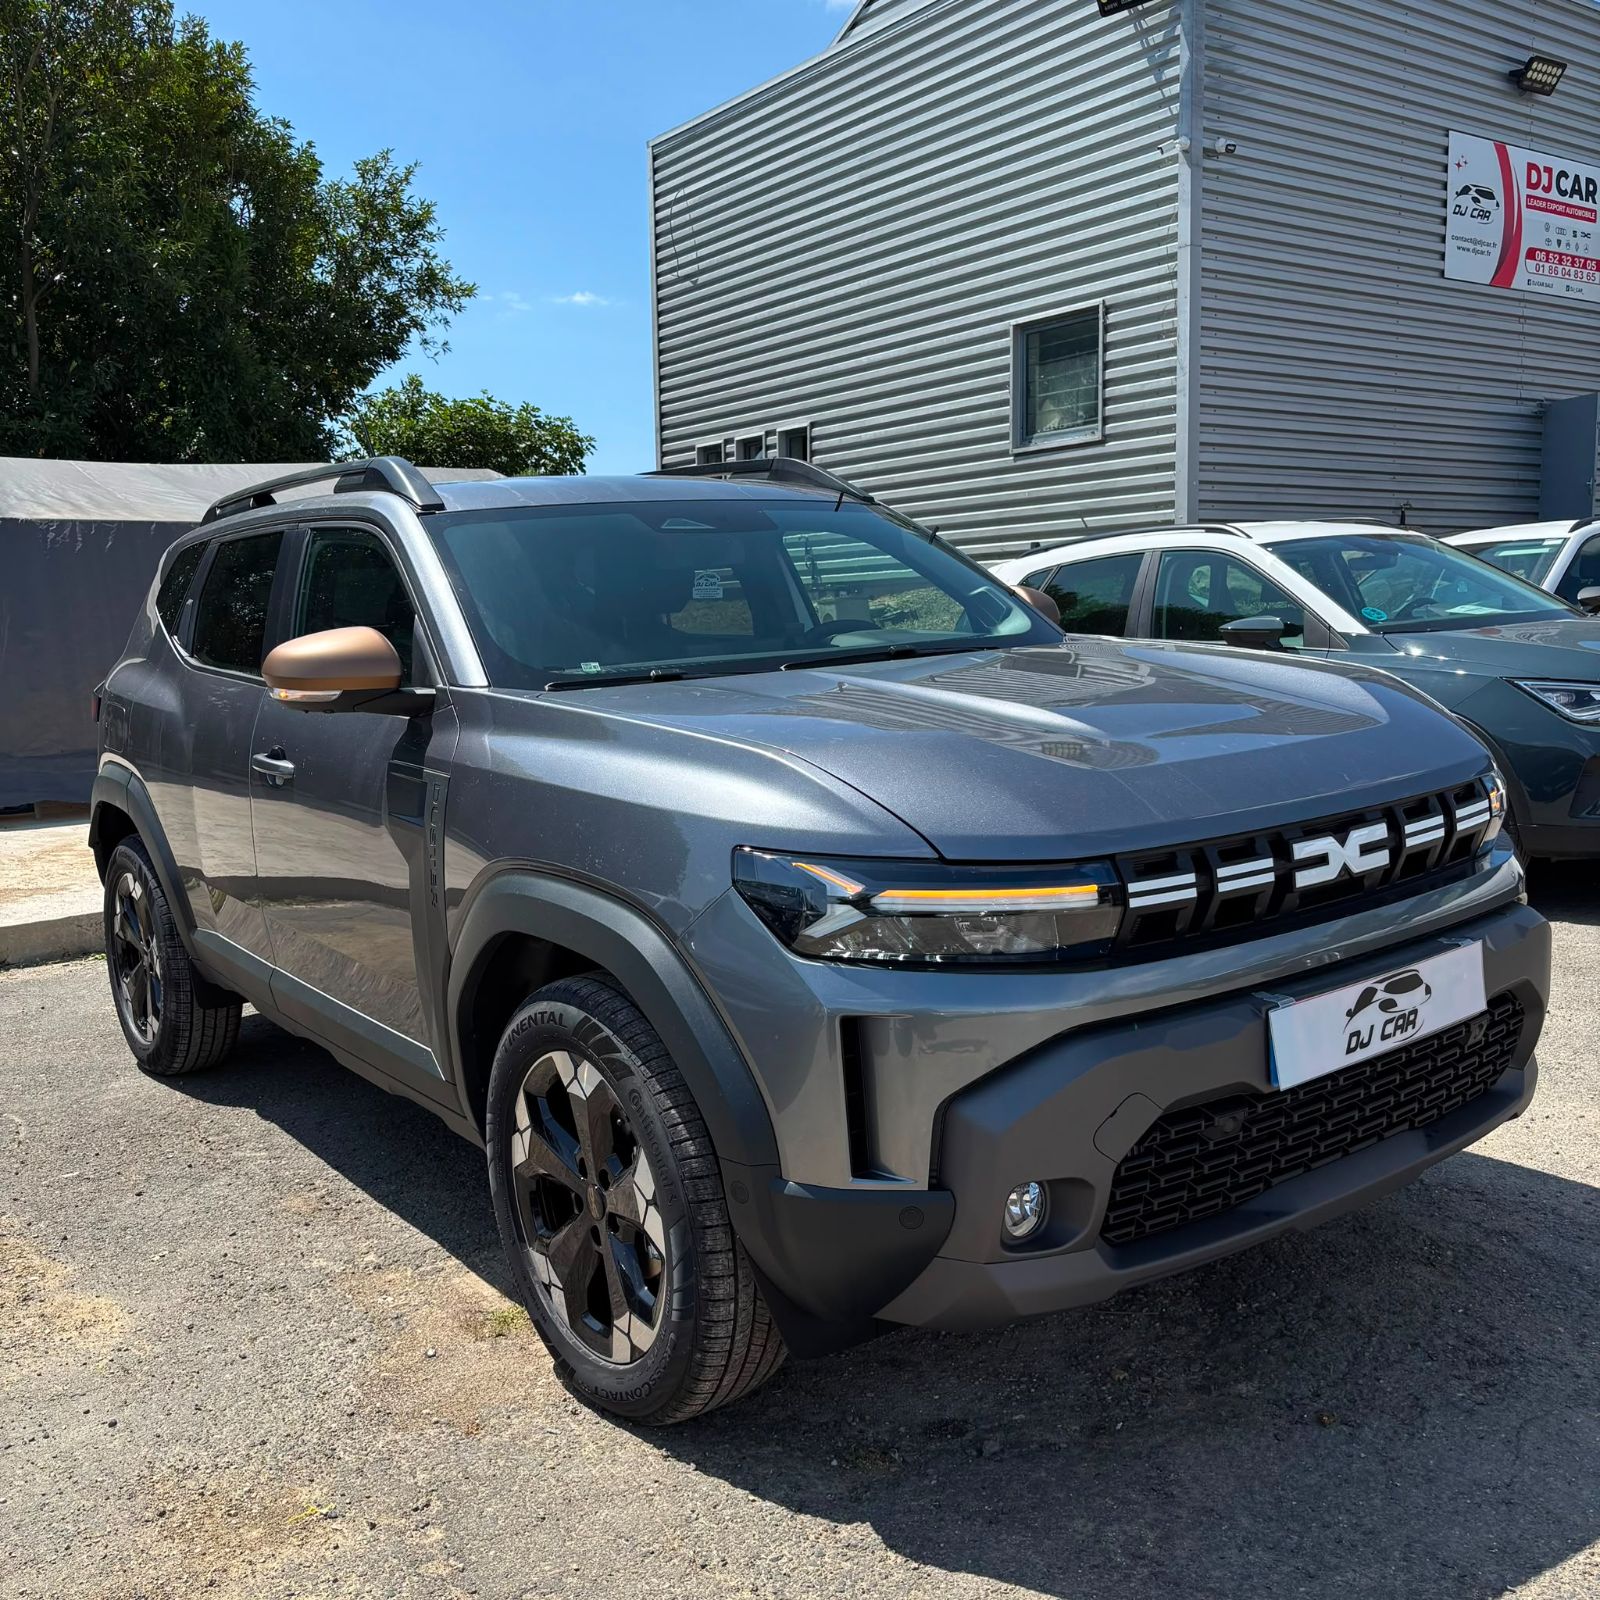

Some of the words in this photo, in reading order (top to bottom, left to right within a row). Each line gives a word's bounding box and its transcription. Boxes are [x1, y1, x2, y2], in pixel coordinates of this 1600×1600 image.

[1453, 204, 1468, 216] DJ
[1470, 207, 1491, 221] CAR
[1527, 198, 1546, 209] LEADER
[1547, 202, 1565, 213] EXPORT
[1566, 206, 1596, 219] AUTOMOBILE
[1451, 234, 1497, 249] contact@djcar.fr
[1456, 245, 1491, 257] www.djcar.fr
[1535, 250, 1546, 261] 06
[1548, 253, 1559, 264] 52
[1561, 255, 1572, 266] 32
[1574, 257, 1584, 268] 37
[1586, 260, 1597, 270] 05
[1535, 263, 1545, 273] 01
[1548, 265, 1559, 275] 86
[1561, 267, 1571, 278] 04
[1573, 269, 1584, 280] 83
[1586, 271, 1596, 282] 65
[429, 783, 441, 908] DUSTER
[1345, 1024, 1374, 1055] DJ
[1380, 1008, 1419, 1041] CAR
